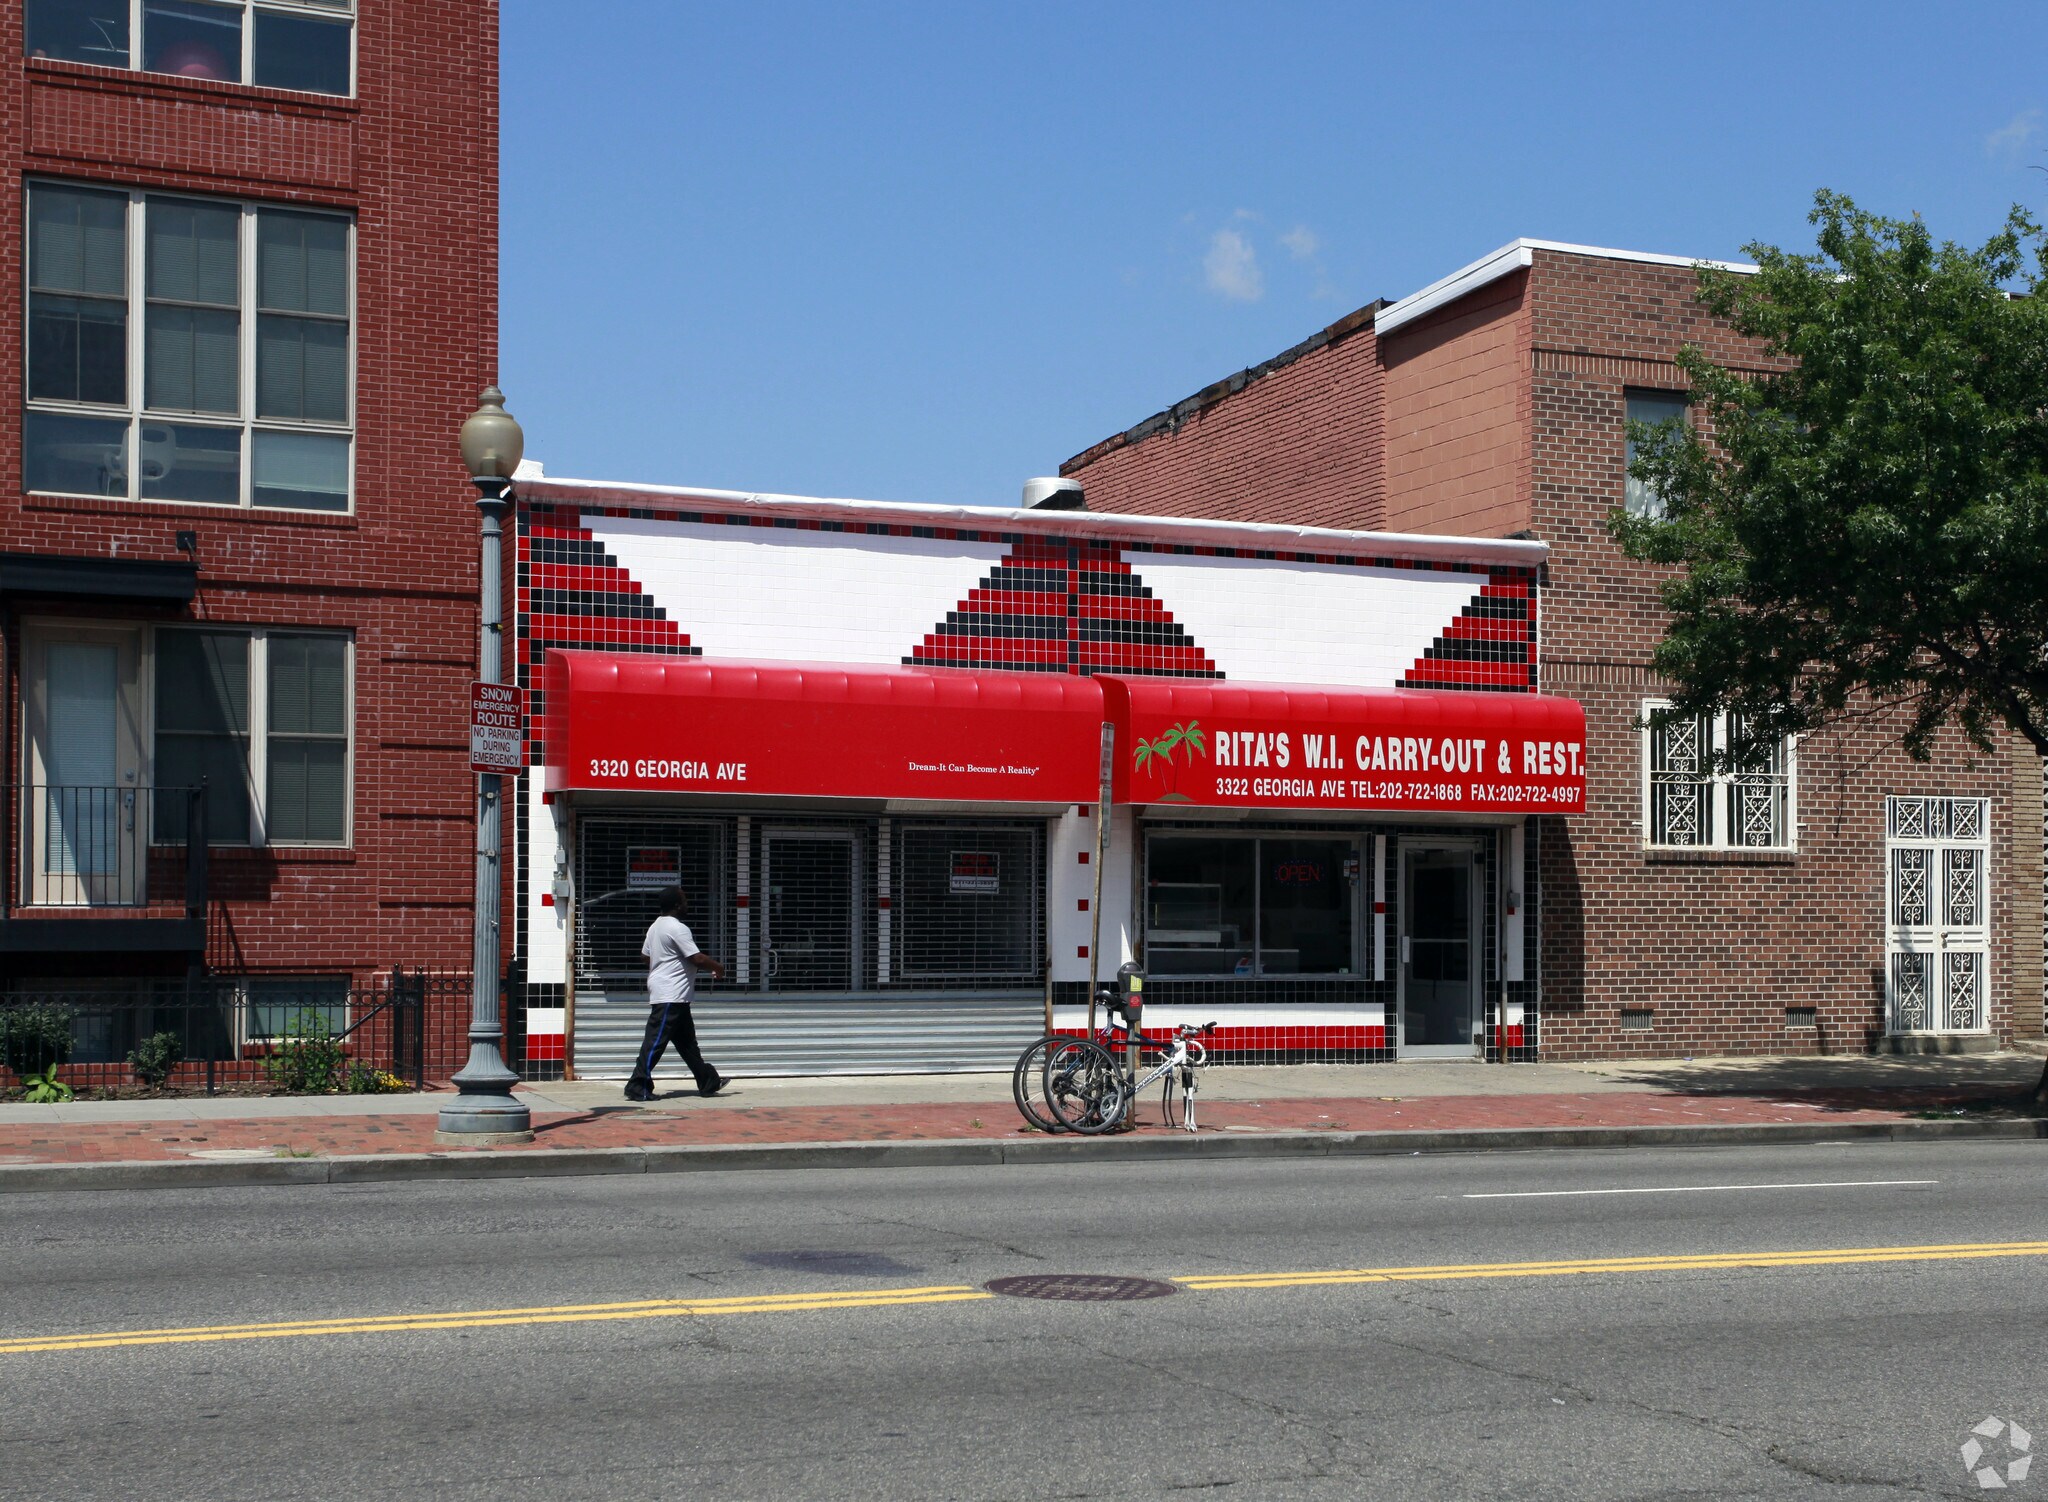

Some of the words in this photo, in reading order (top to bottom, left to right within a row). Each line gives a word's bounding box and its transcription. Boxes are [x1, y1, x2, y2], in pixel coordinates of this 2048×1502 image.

[480, 687, 513, 702] SNOW
[473, 700, 520, 713] EMERGENCY
[477, 711, 516, 727] ROUTE
[473, 726, 485, 738] NO
[488, 728, 519, 741] PARKING
[482, 740, 510, 752] DURING
[1215, 730, 1290, 768] RITA'S
[1302, 733, 1344, 770] W.I.
[1355, 735, 1486, 774] CARRY-OUT
[1497, 739, 1512, 774] &
[1523, 741, 1584, 777] REST.
[473, 751, 519, 766] EMERGENCY
[590, 759, 629, 777] 3320
[634, 759, 710, 780] GEORGIA
[715, 762, 747, 781] AVE
[948, 763, 965, 773] Can
[967, 764, 998, 774] Become
[999, 765, 1006, 774] A
[1216, 777, 1250, 796] 3322
[1253, 778, 1316, 797] GEORGIA
[1320, 779, 1346, 798] AVE
[1350, 780, 1462, 801] TEL:202-722-1868
[1471, 783, 1581, 803] FAX:202-722-4997
[1278, 864, 1320, 882] OPEN
